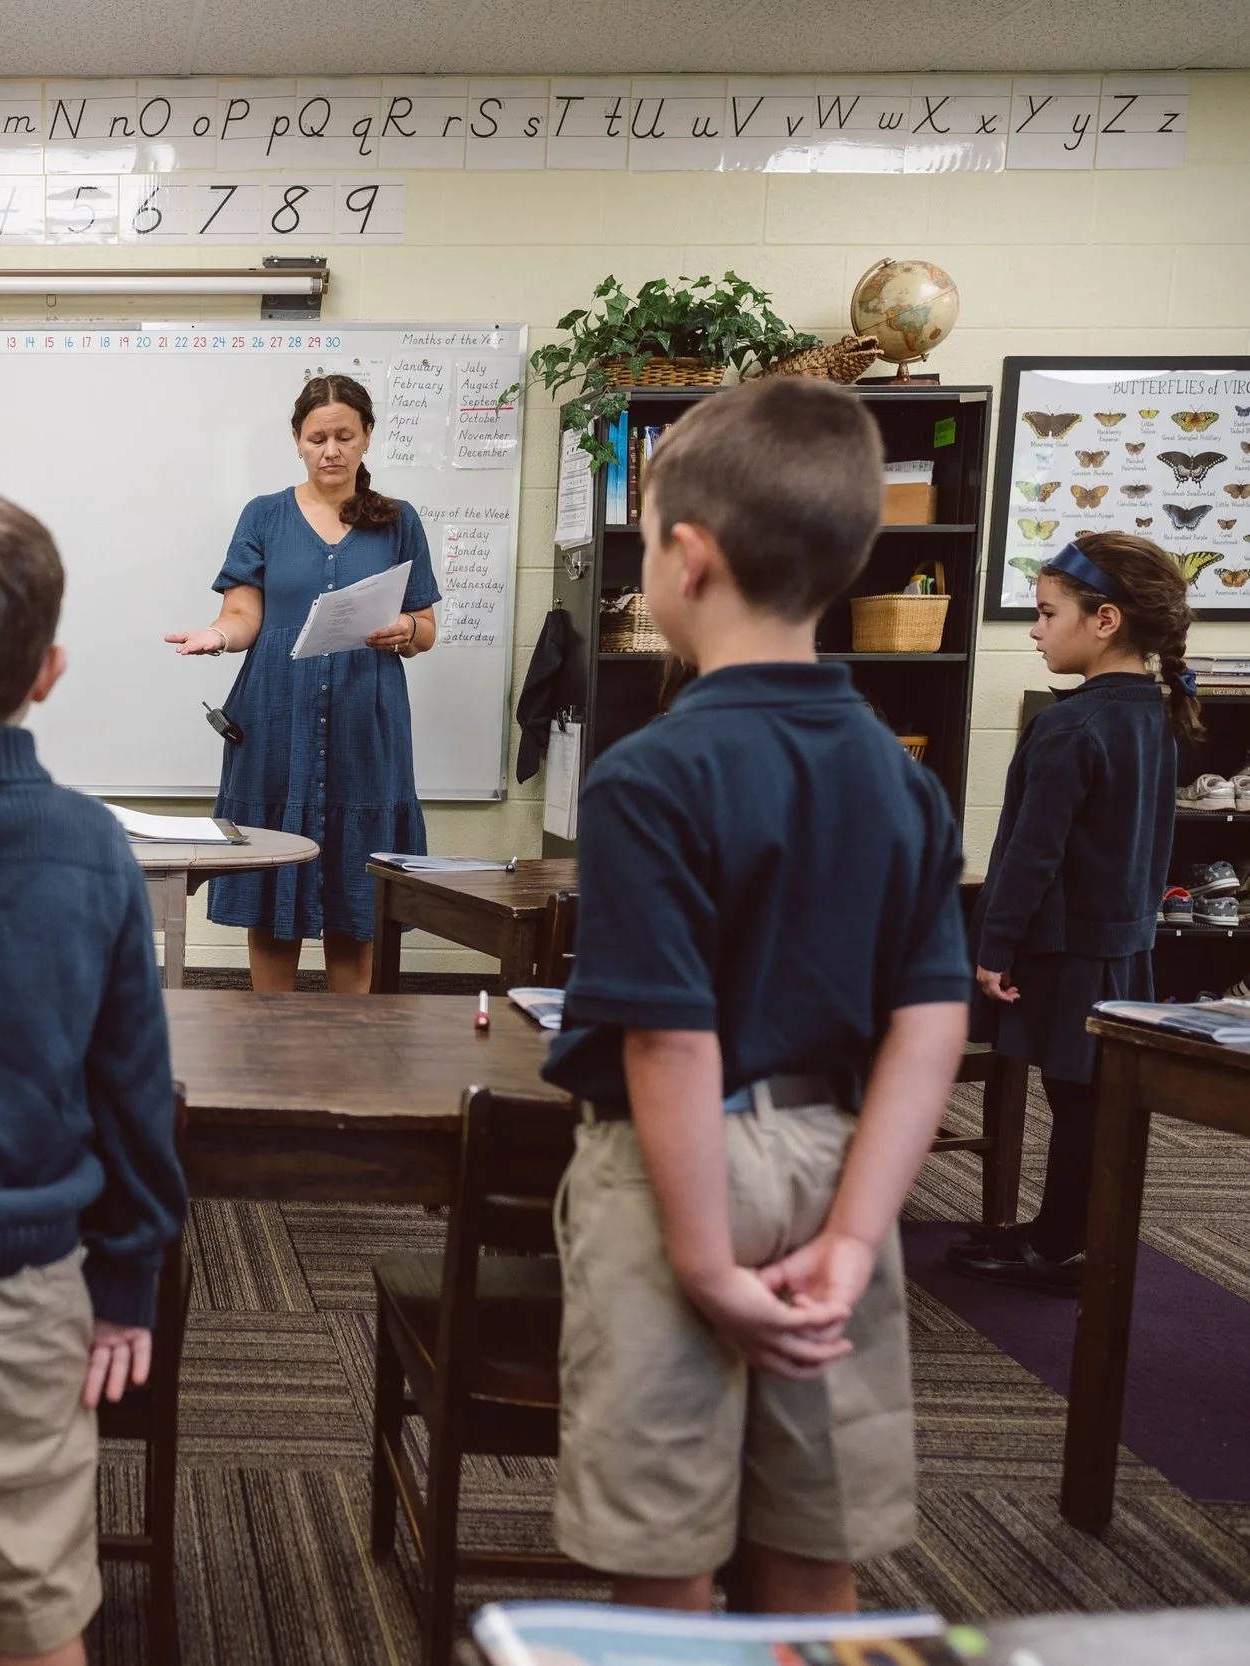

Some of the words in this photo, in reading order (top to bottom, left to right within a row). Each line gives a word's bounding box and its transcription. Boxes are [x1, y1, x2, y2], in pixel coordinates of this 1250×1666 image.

[66, 185, 99, 234] 5
[131, 185, 163, 235] 6
[199, 185, 239, 235] 7
[271, 185, 310, 235] 8
[345, 184, 380, 234] 9
[6, 336, 17, 348] 13
[25, 336, 36, 348] 14
[44, 336, 55, 348] 15
[64, 336, 74, 348] 16
[82, 336, 92, 348] 17
[100, 336, 111, 348] 18
[119, 336, 130, 348] 19
[136, 336, 152, 348] 20
[158, 336, 168, 348] 21
[174, 336, 188, 348] 22
[193, 336, 207, 348] 23
[212, 336, 227, 348] 24
[231, 336, 245, 348] 25
[251, 336, 265, 349] 26
[270, 336, 283, 348] 27
[287, 336, 302, 348] 28
[307, 336, 322, 349] 29
[325, 336, 341, 349] 30
[402, 334, 441, 345] Months
[445, 334, 457, 345] of
[460, 333, 478, 345] the
[480, 334, 504, 345] Yer
[394, 360, 443, 377] January
[461, 361, 487, 377] July
[392, 377, 444, 395] February
[461, 379, 499, 394] August
[1113, 379, 1205, 395] BUTTERFLIES
[1208, 379, 1220, 395] of
[391, 394, 428, 408] March
[461, 395, 513, 409] Septemer
[390, 413, 420, 429] April
[459, 412, 501, 423] October
[388, 430, 413, 447] May
[458, 429, 510, 440] November
[387, 449, 415, 461] June
[458, 446, 508, 458] December
[419, 506, 446, 521] Days
[449, 507, 461, 517] of
[464, 507, 481, 518] the
[484, 507, 510, 519] Week
[448, 528, 490, 543] Sunday
[447, 545, 491, 560] Monday
[446, 561, 489, 576] Tuesday
[446, 578, 505, 593] Wednesday
[445, 597, 495, 613] Thursday
[444, 613, 481, 629] Friday
[443, 630, 495, 645] Saturday
